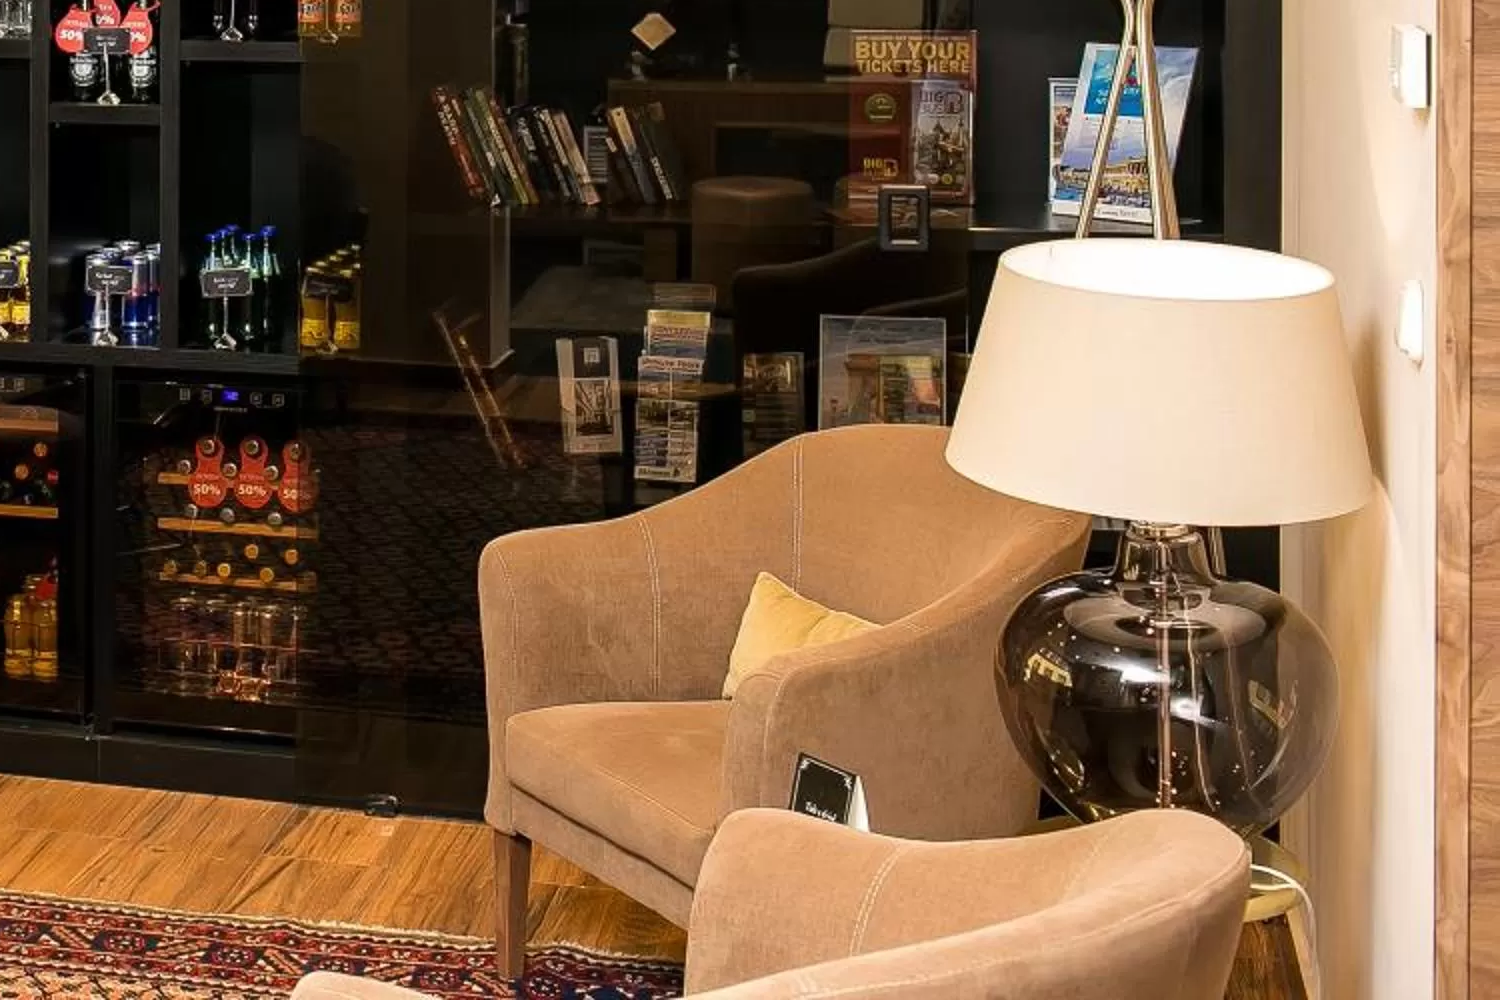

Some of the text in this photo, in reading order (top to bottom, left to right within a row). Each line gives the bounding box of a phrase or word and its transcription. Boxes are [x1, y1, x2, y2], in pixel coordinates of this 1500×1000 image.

[855, 41, 970, 60] BUY YOUR
[856, 59, 971, 73] TICKETS HERE
[194, 483, 221, 496] 50%
[238, 484, 267, 497] 50%
